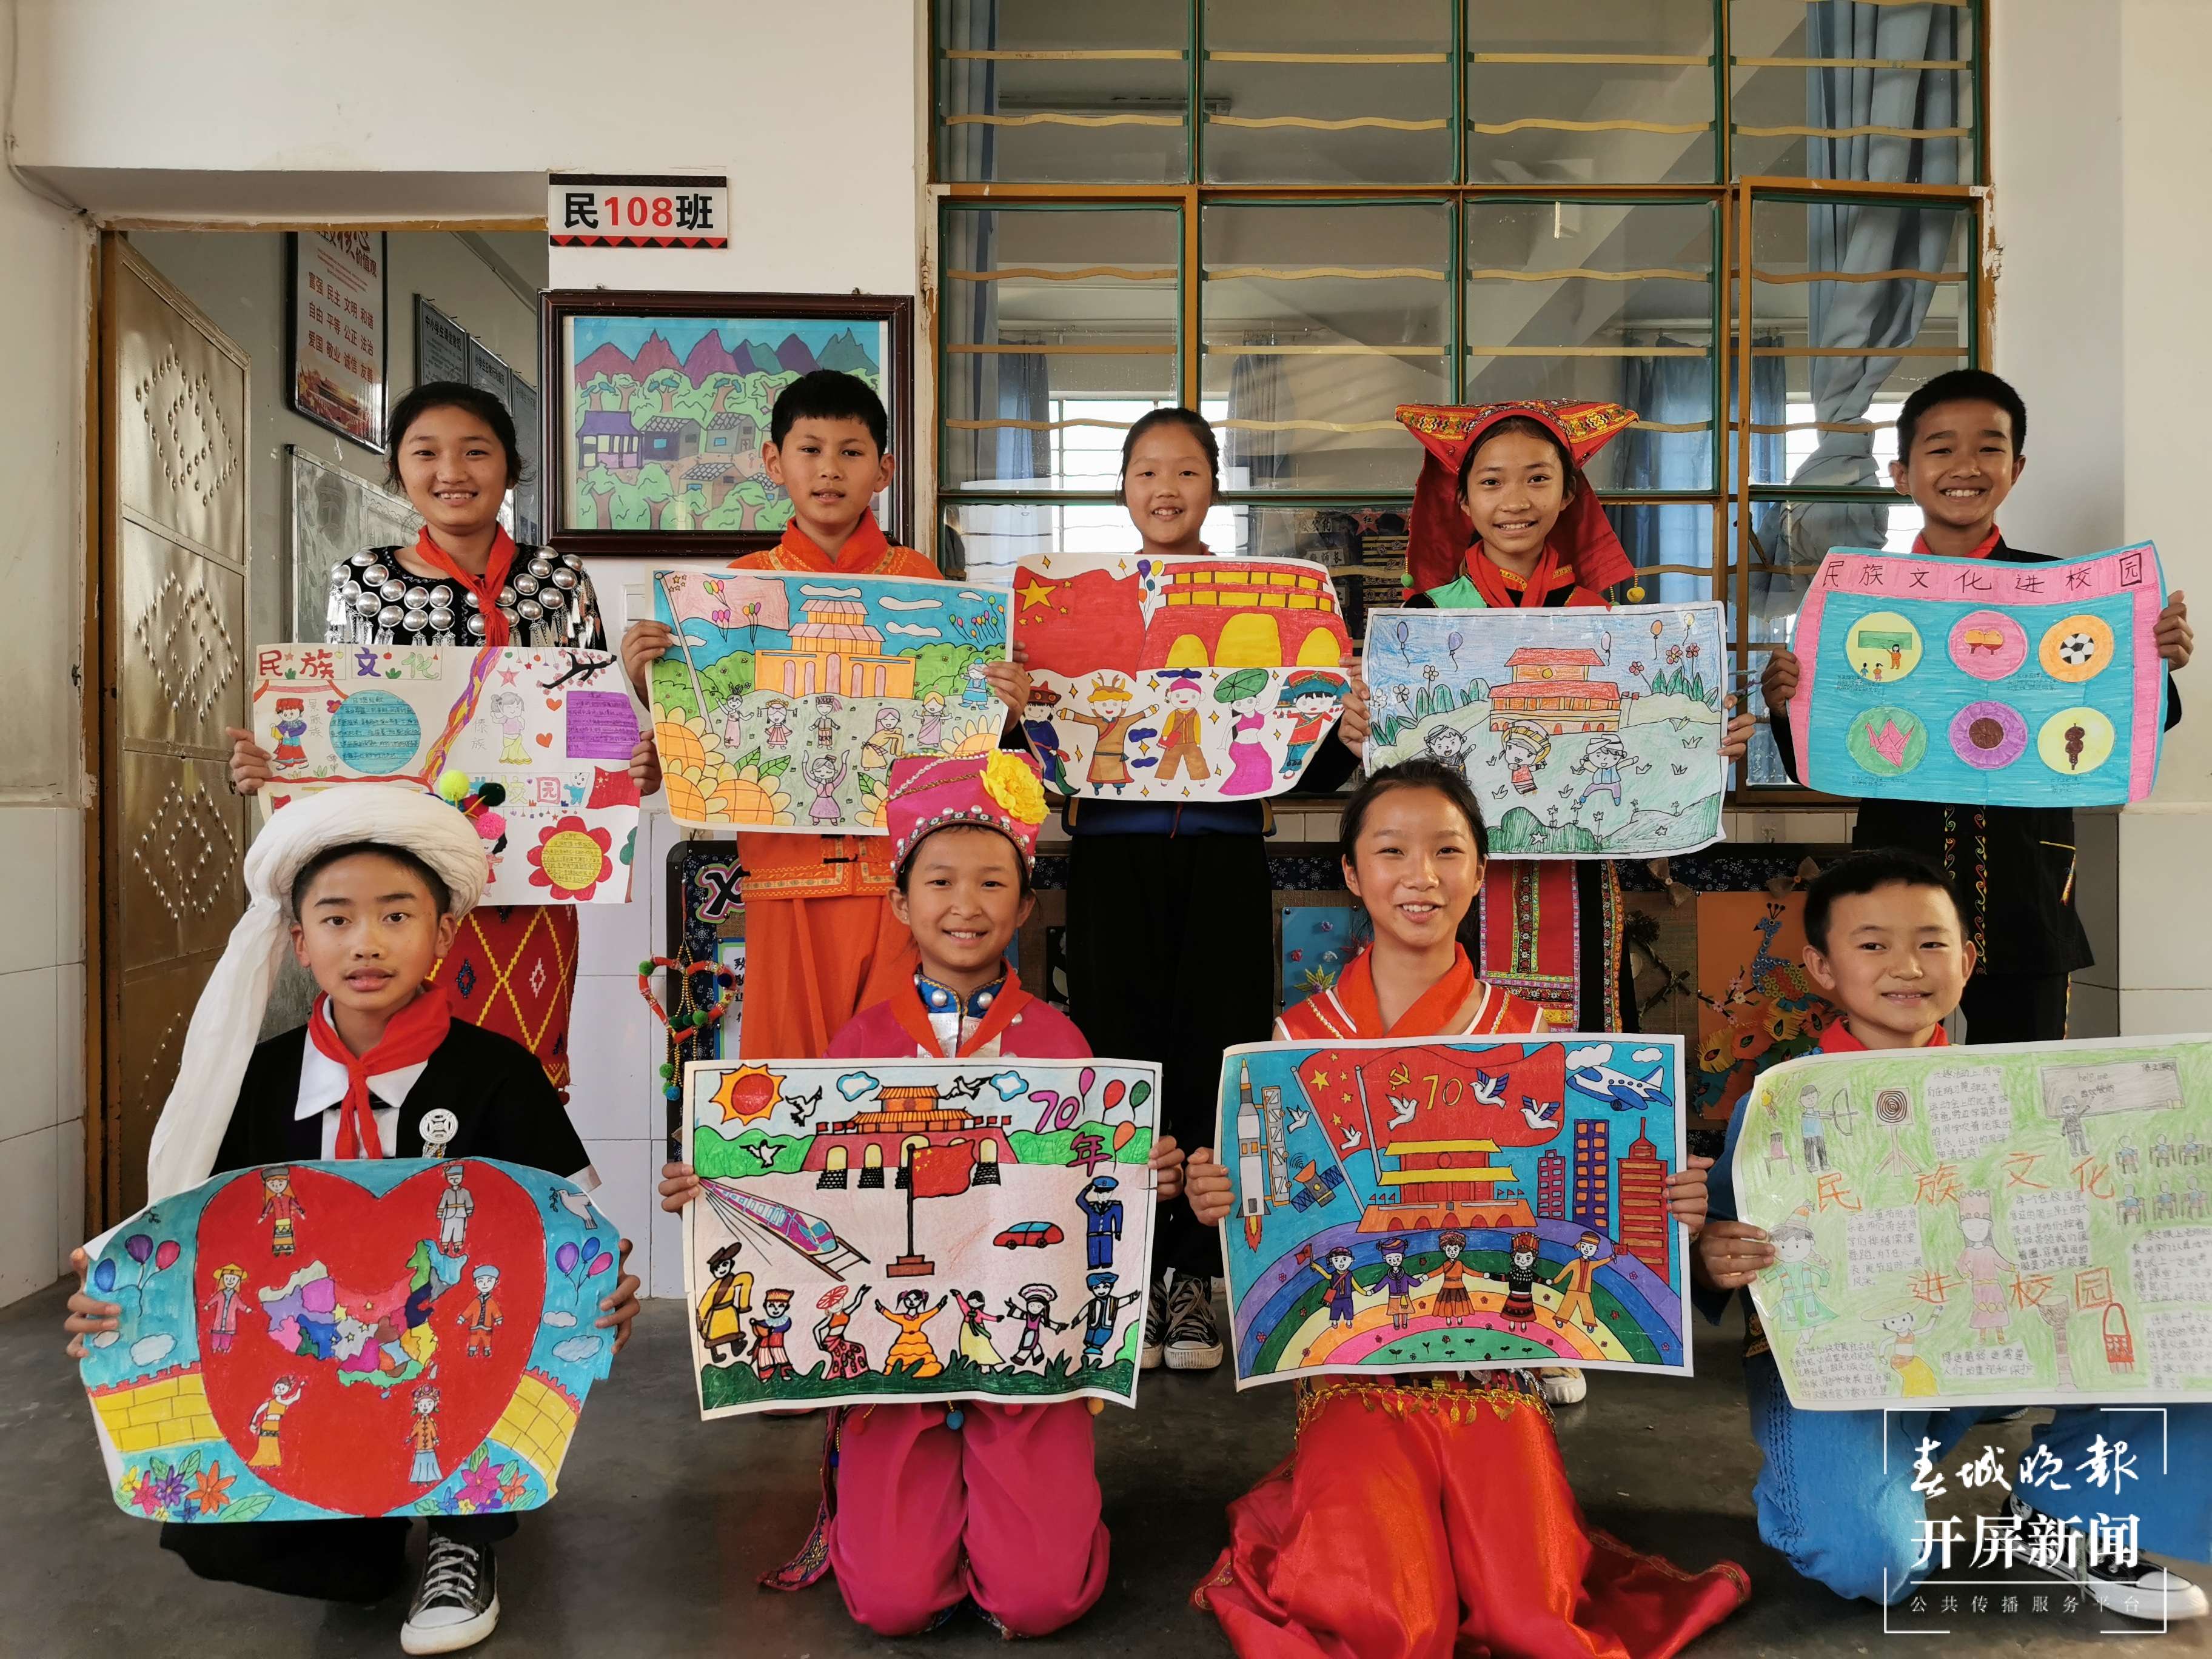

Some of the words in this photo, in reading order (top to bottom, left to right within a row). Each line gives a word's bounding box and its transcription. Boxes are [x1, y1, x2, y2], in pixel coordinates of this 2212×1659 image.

[565, 193, 714, 230] 民108班
[309, 272, 323, 297] 富强
[327, 284, 341, 307] 民主
[344, 297, 358, 320] 文明
[360, 308, 374, 330] 和谐
[309, 301, 323, 324] 自由
[326, 313, 341, 335] 平等
[343, 324, 358, 347] 公正
[360, 335, 374, 357] 法治
[308, 330, 323, 354] 爱国
[326, 341, 341, 364] 敬业
[344, 352, 358, 374] 诚信
[360, 363, 374, 384] 友善
[1822, 552, 2143, 595] 民族文化进校园
[258, 646, 440, 680] 民族文化
[1030, 1090, 1079, 1133] 70
[1422, 1073, 1464, 1111] 70
[1066, 1134, 1112, 1178] 年
[1817, 1151, 2116, 1213] 民族文化
[1906, 1267, 2113, 1310] 进校园
